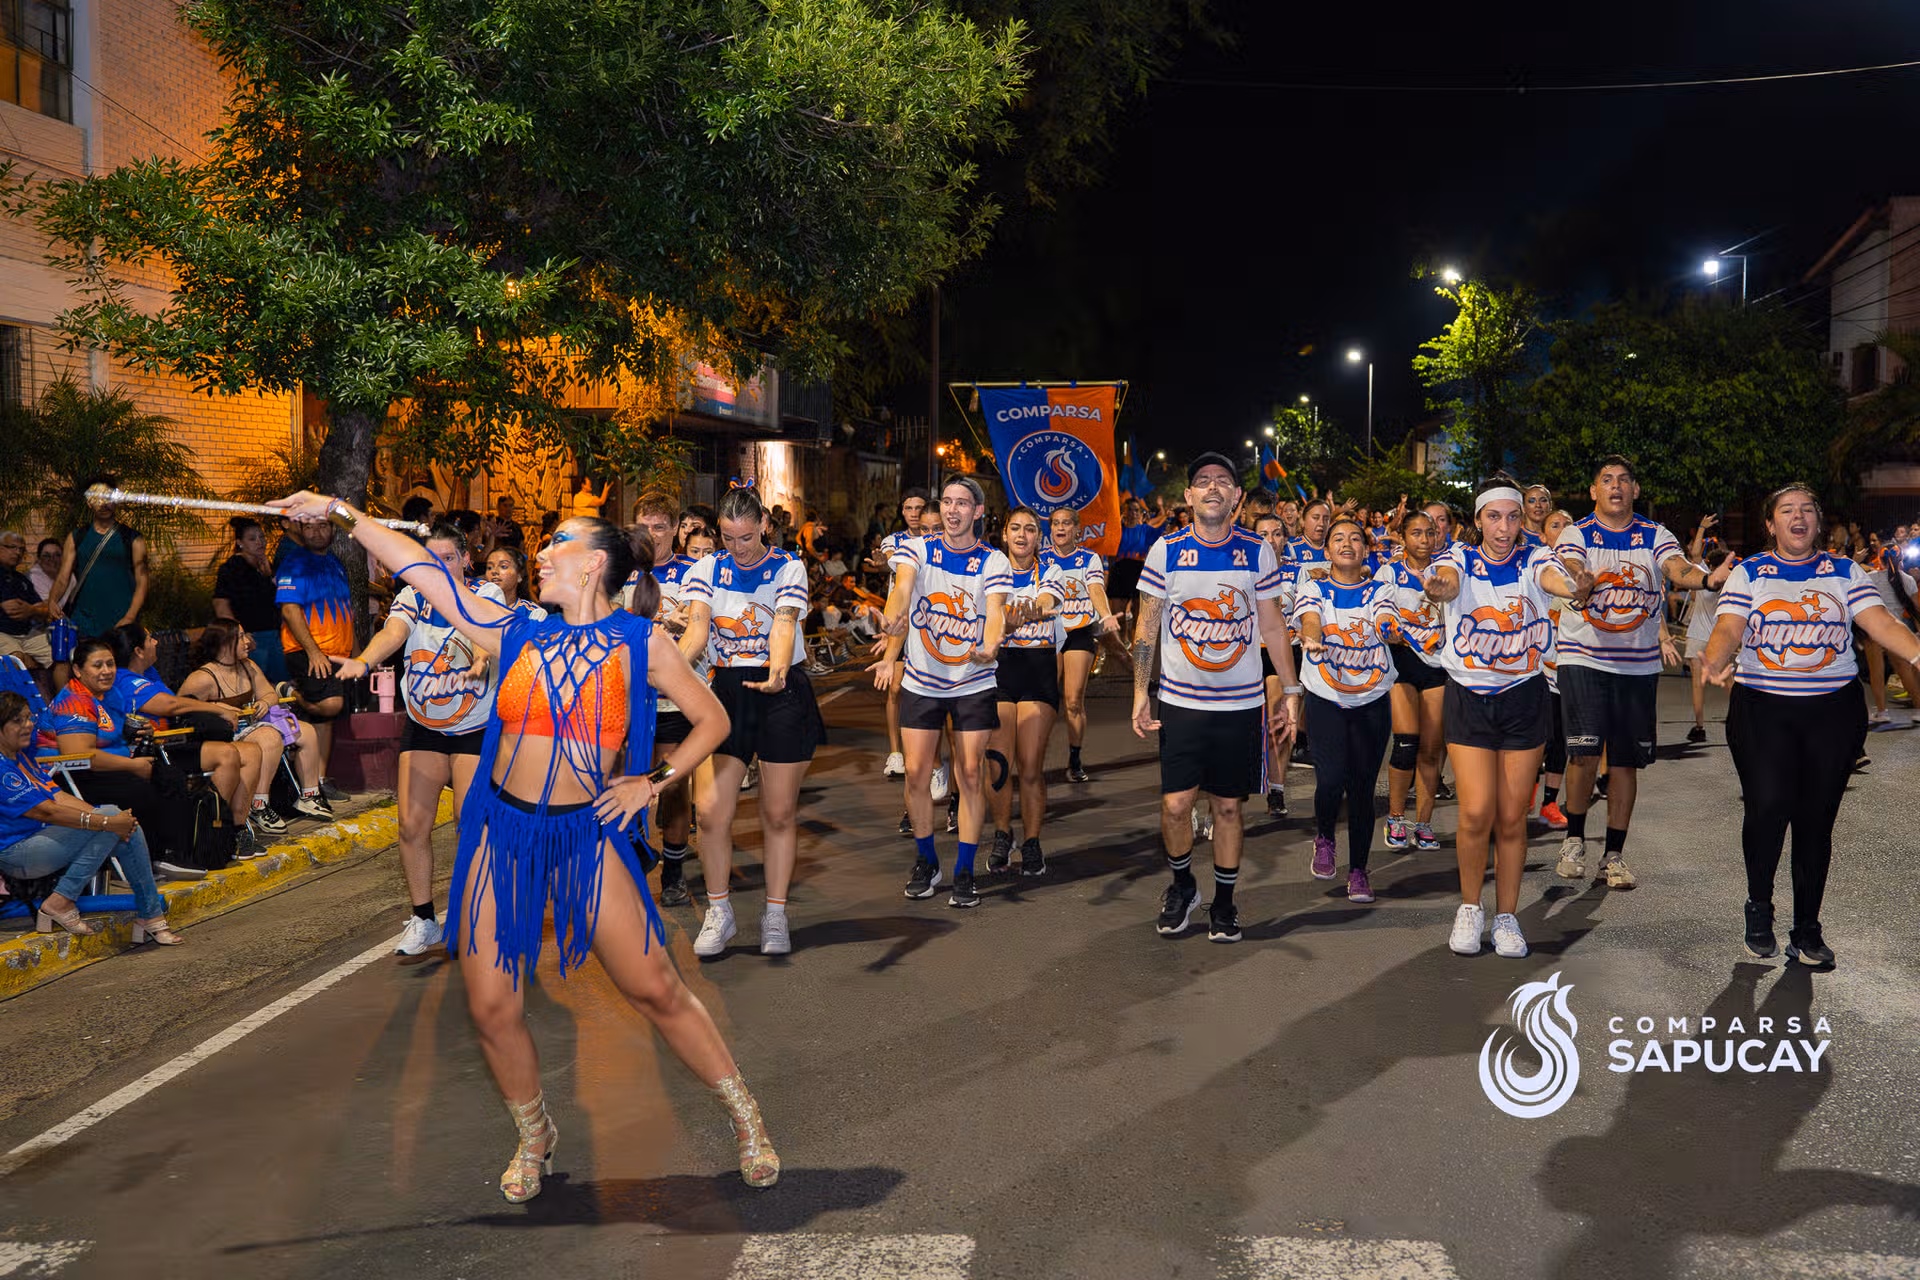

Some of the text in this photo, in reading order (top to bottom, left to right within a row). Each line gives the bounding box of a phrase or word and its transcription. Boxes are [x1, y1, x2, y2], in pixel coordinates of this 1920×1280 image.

[996, 404, 1102, 422] COMPARSA
[1020, 434, 1084, 454] COMPARSA
[1034, 496, 1084, 514] SAPAY
[1177, 549, 1199, 567] 20
[1757, 560, 1835, 576] 20 26
[1169, 603, 1254, 646] Sapucay
[1745, 609, 1850, 655] Sapucay
